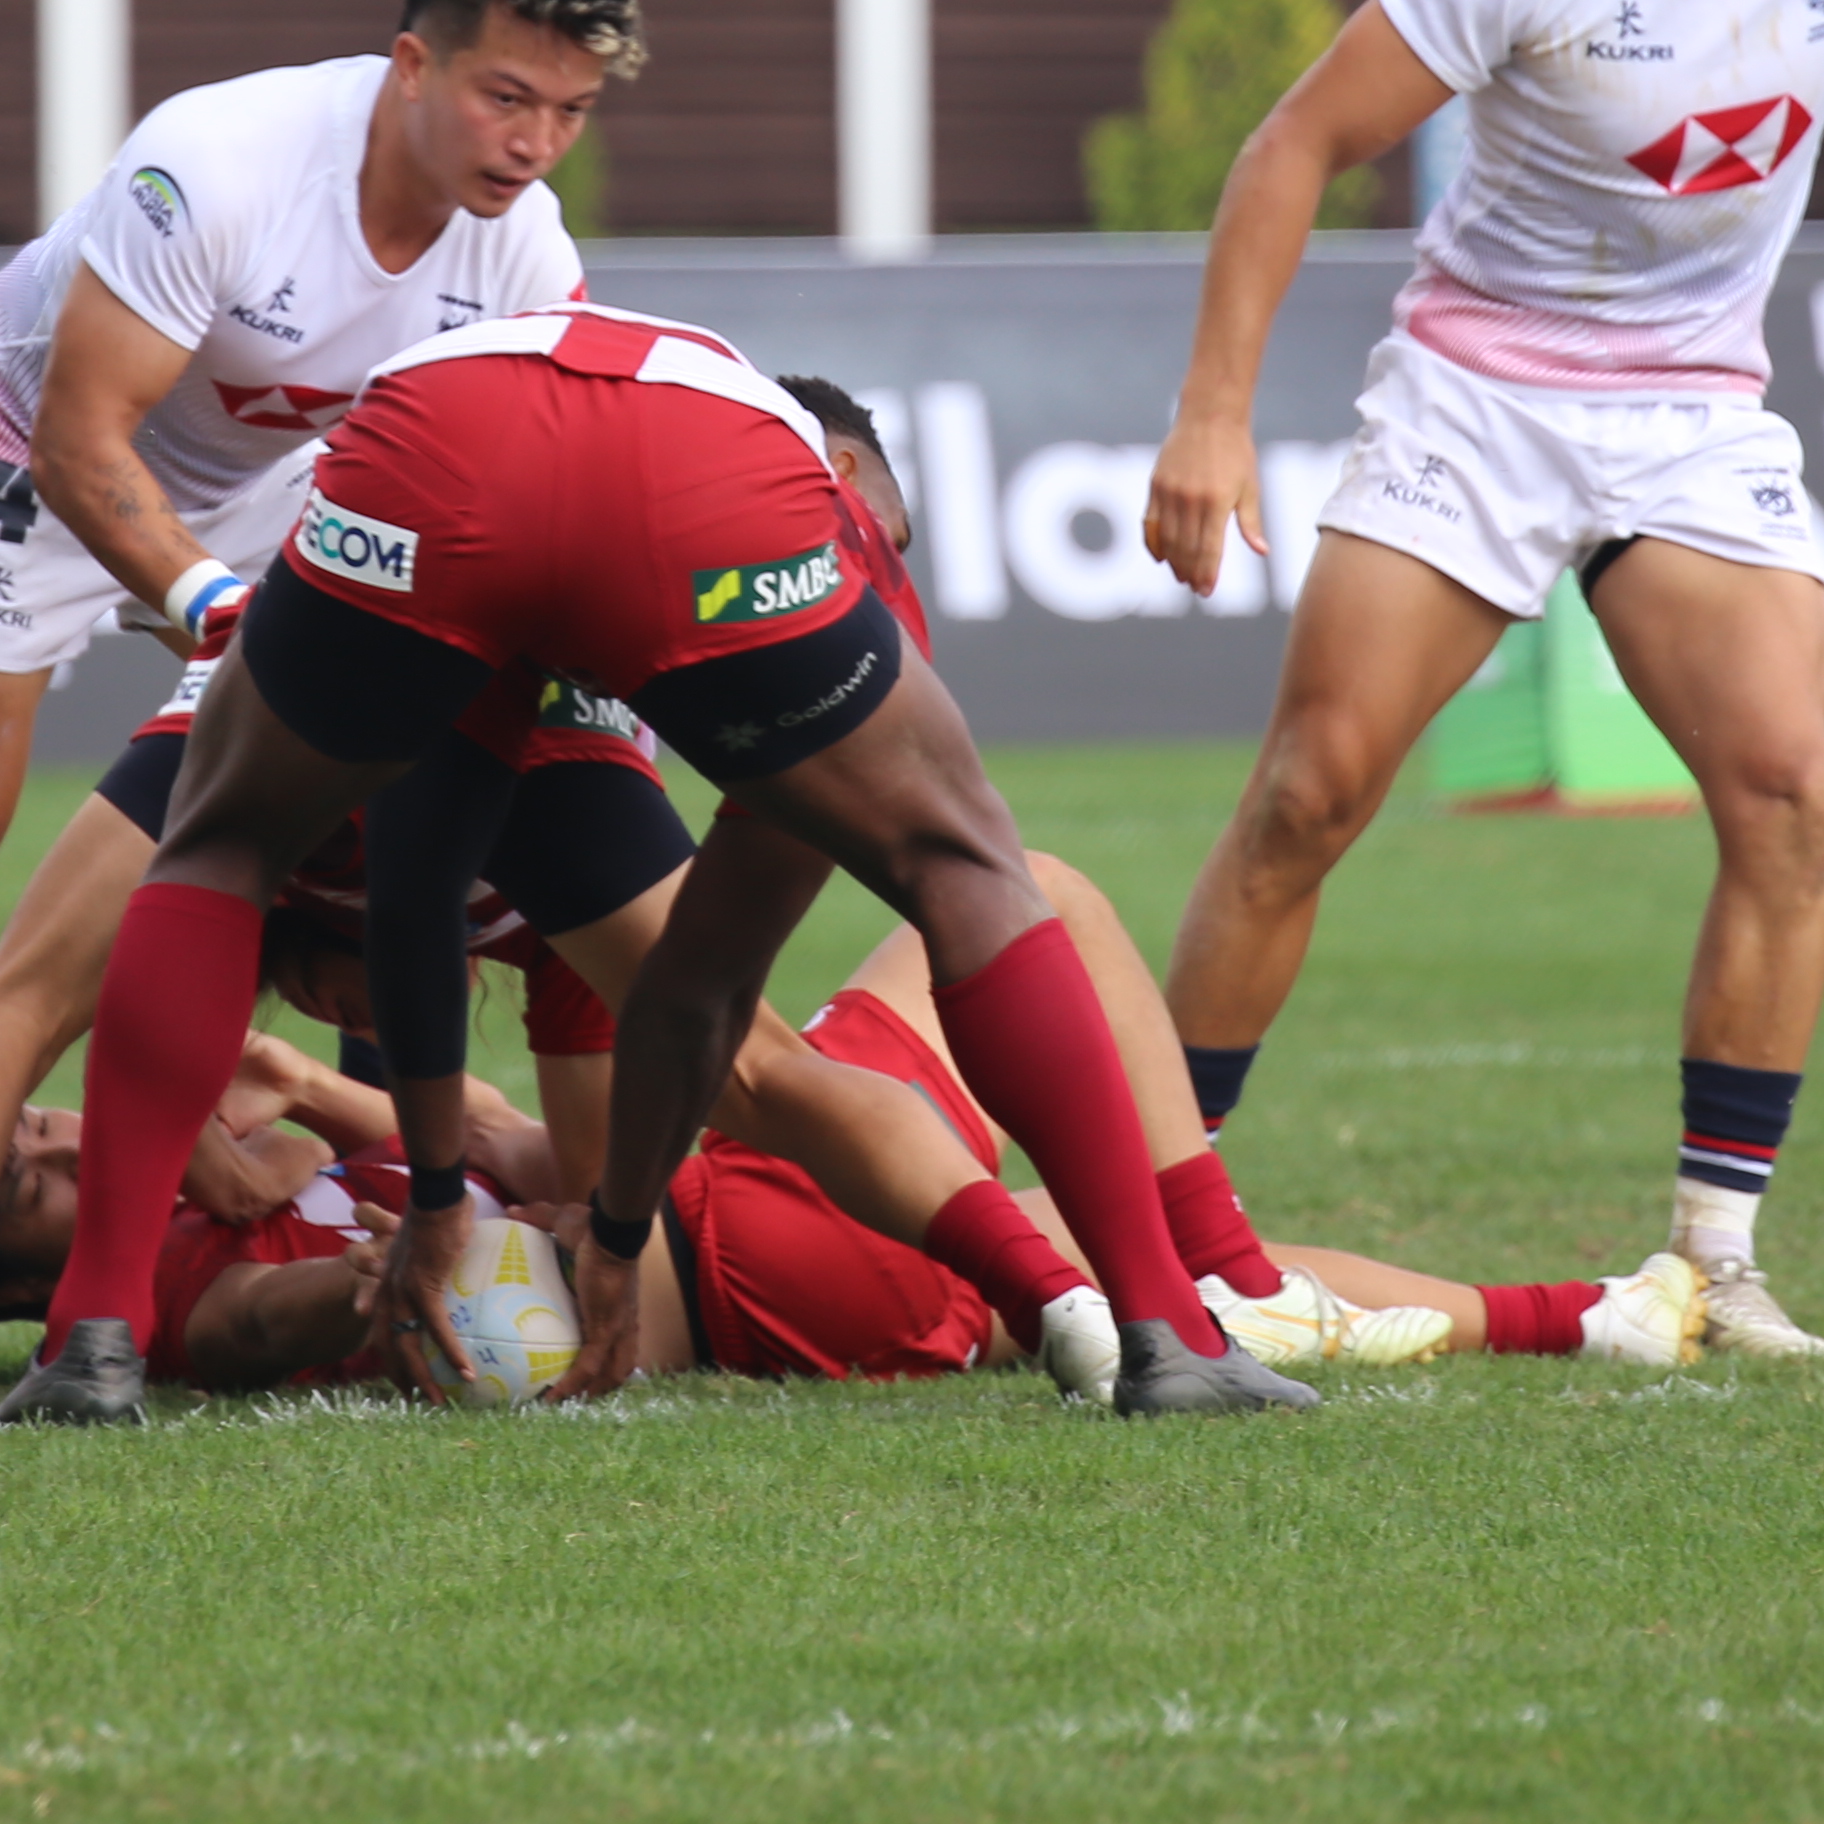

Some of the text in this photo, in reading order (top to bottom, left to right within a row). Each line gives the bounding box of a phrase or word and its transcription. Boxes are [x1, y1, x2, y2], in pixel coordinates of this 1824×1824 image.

[1586, 41, 1674, 61] KUKRI
[229, 304, 304, 344] KUKRI
[1382, 479, 1461, 522] KUKRI
[776, 651, 878, 728] Goldwin
